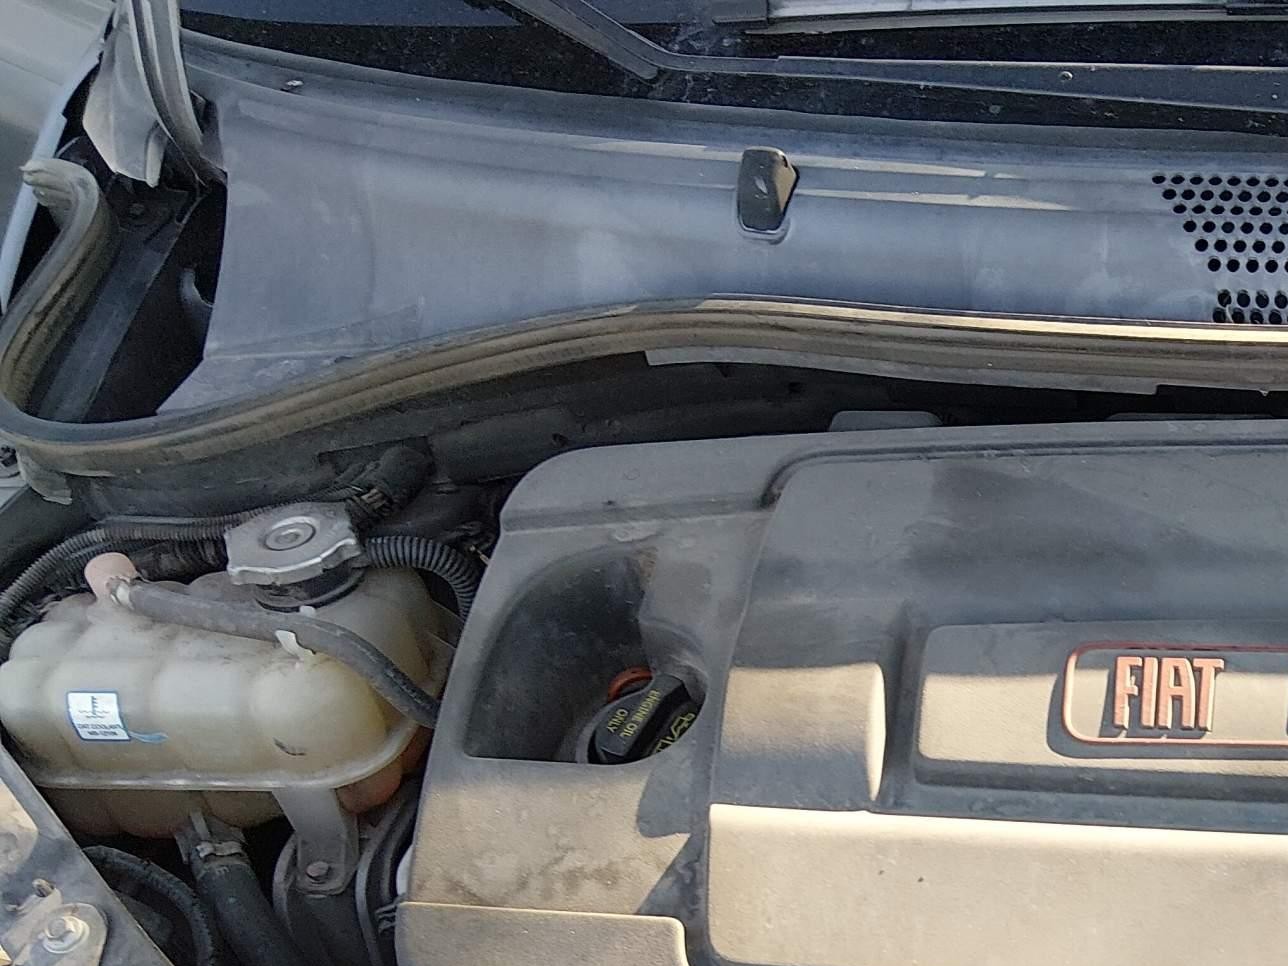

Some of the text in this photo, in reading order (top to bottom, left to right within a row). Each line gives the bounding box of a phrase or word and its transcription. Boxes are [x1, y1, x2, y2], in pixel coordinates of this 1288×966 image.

[620, 689, 660, 738] ENGINE OIL
[1113, 656, 1225, 731] FIAT
[607, 708, 629, 733] ONLY
